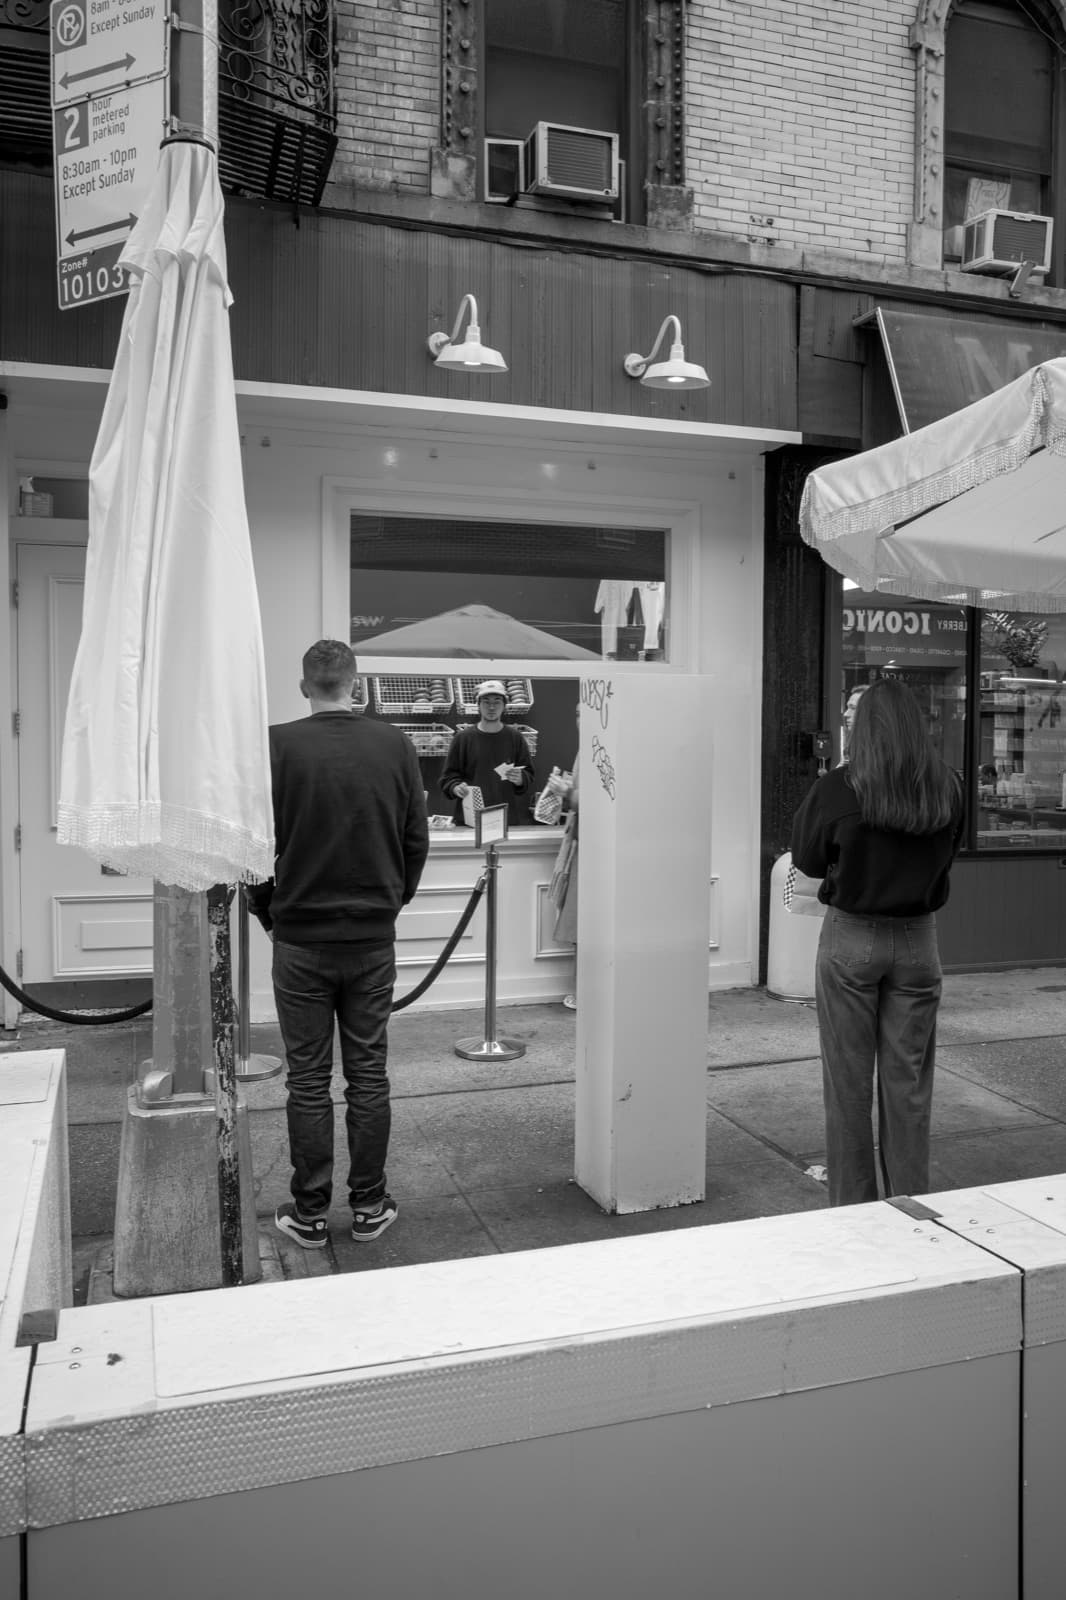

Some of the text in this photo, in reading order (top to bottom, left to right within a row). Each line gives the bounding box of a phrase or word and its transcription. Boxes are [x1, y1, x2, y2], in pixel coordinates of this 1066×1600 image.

[91, 0, 109, 15] 8am
[91, 6, 155, 34] Except Sunday
[92, 97, 112, 112] hour
[92, 104, 130, 126] metered
[64, 106, 80, 149] 2
[92, 121, 125, 143] parking
[62, 160, 100, 181] 8:30am
[110, 148, 137, 167] 10pm
[63, 168, 135, 200] Except Sunday
[61, 258, 88, 274] Zone#
[62, 265, 124, 302] 10103
